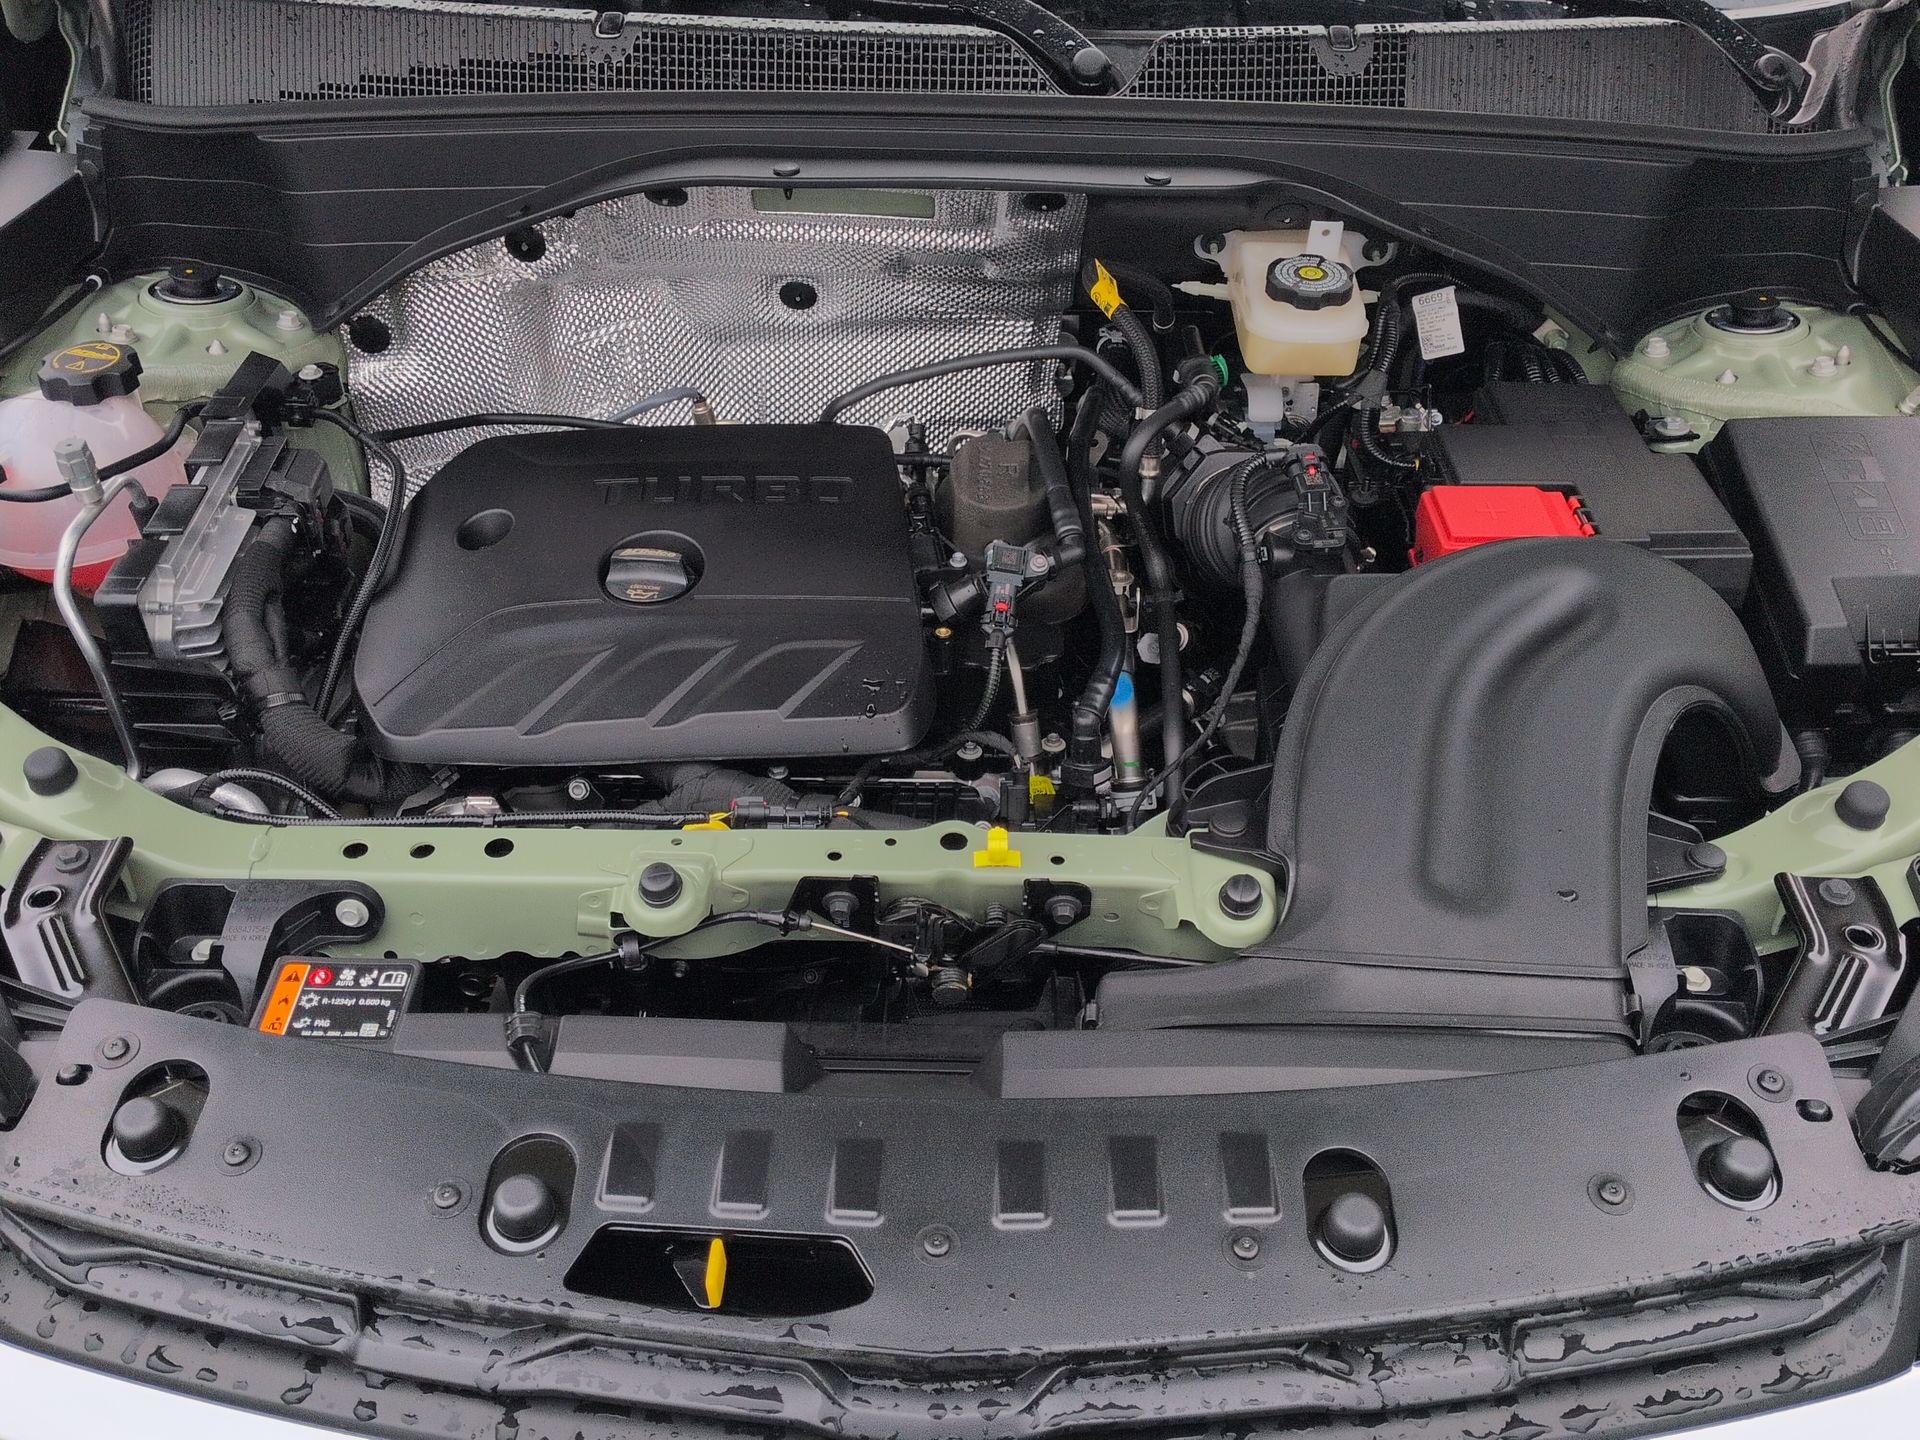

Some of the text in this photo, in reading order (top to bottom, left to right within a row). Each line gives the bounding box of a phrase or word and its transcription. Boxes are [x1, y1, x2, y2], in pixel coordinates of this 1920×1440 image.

[1418, 292, 1443, 305] 6669
[593, 475, 853, 504] TURBO
[321, 998, 357, 1006] R-1234yf
[380, 998, 391, 1007] kg
[313, 1019, 331, 1027] PAG
